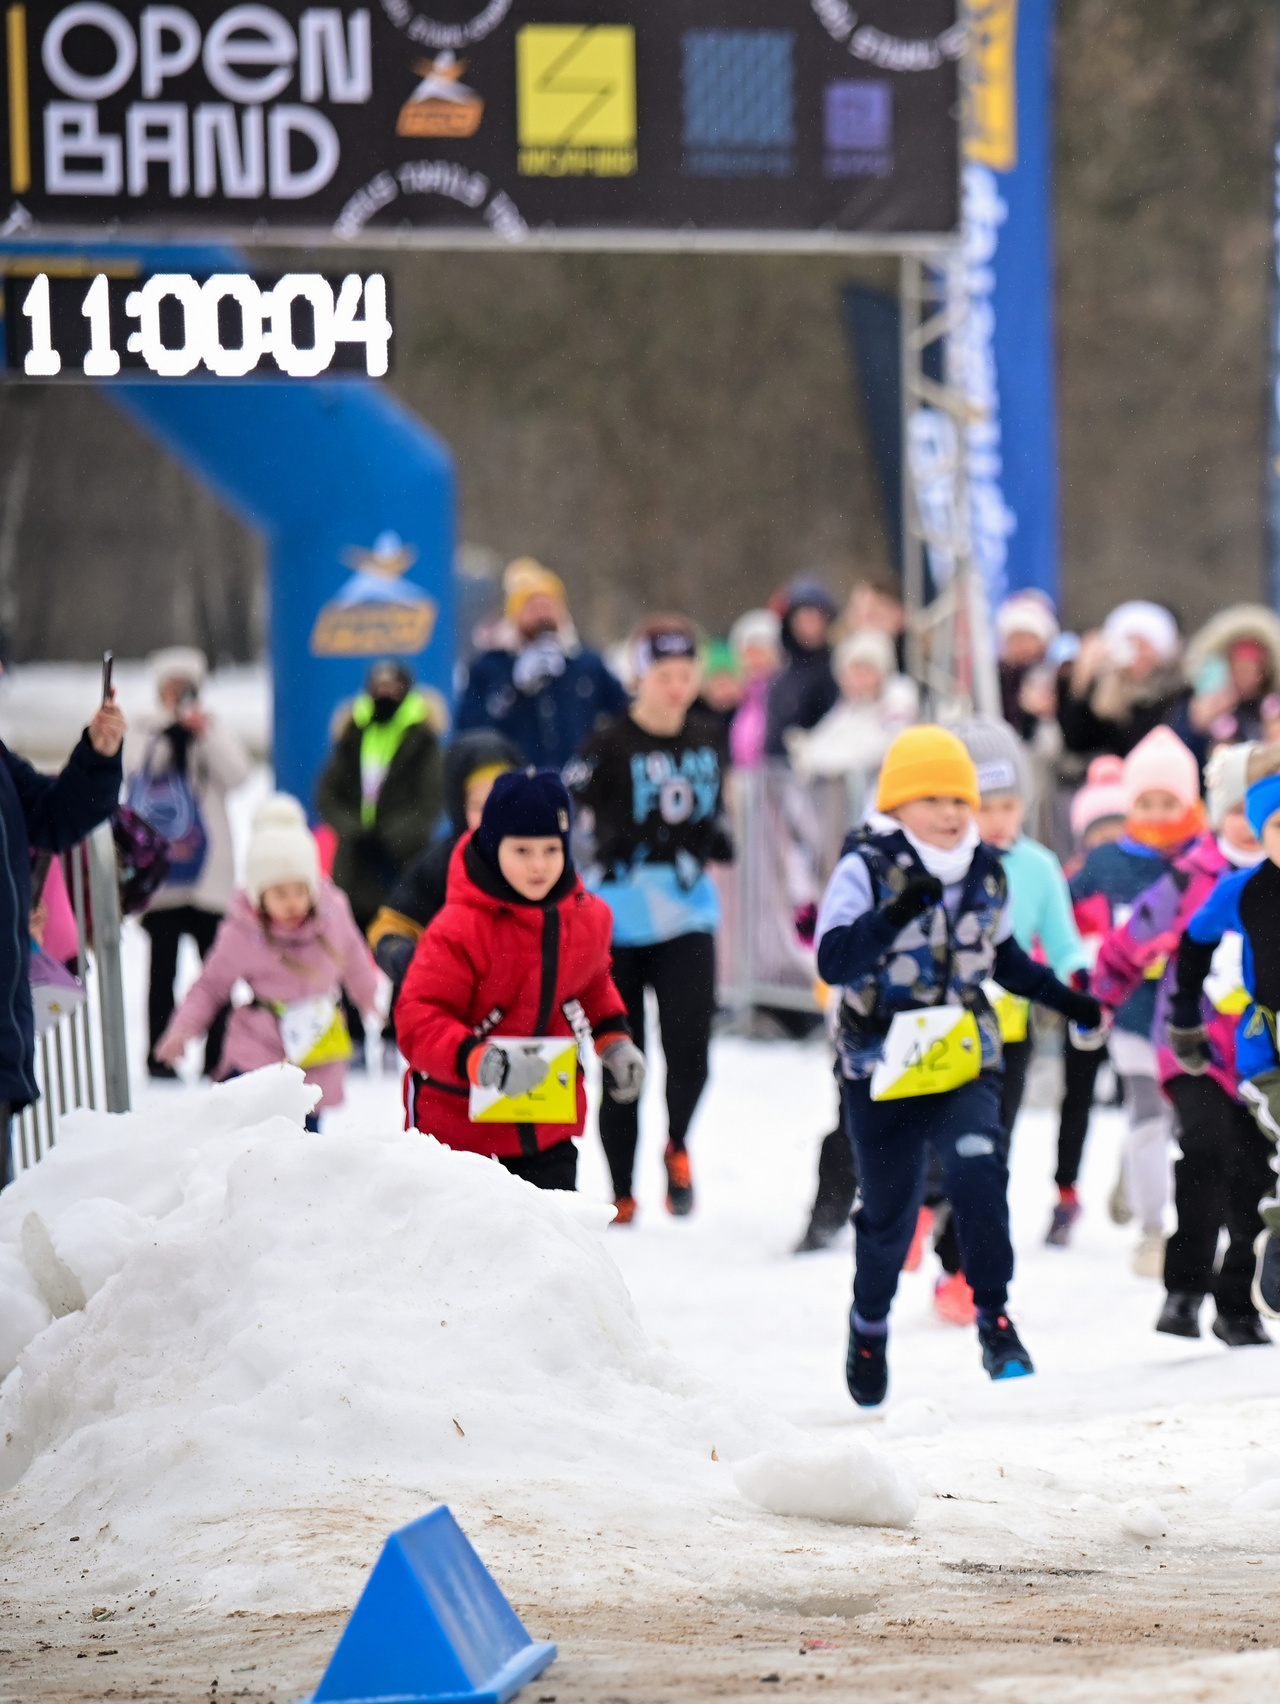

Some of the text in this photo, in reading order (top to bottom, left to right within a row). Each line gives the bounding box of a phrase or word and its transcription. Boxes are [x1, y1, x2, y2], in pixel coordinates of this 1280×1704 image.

[43, 100, 340, 198] BAND
[22, 273, 393, 376] 11:00:04
[902, 1036, 952, 1074] 42
